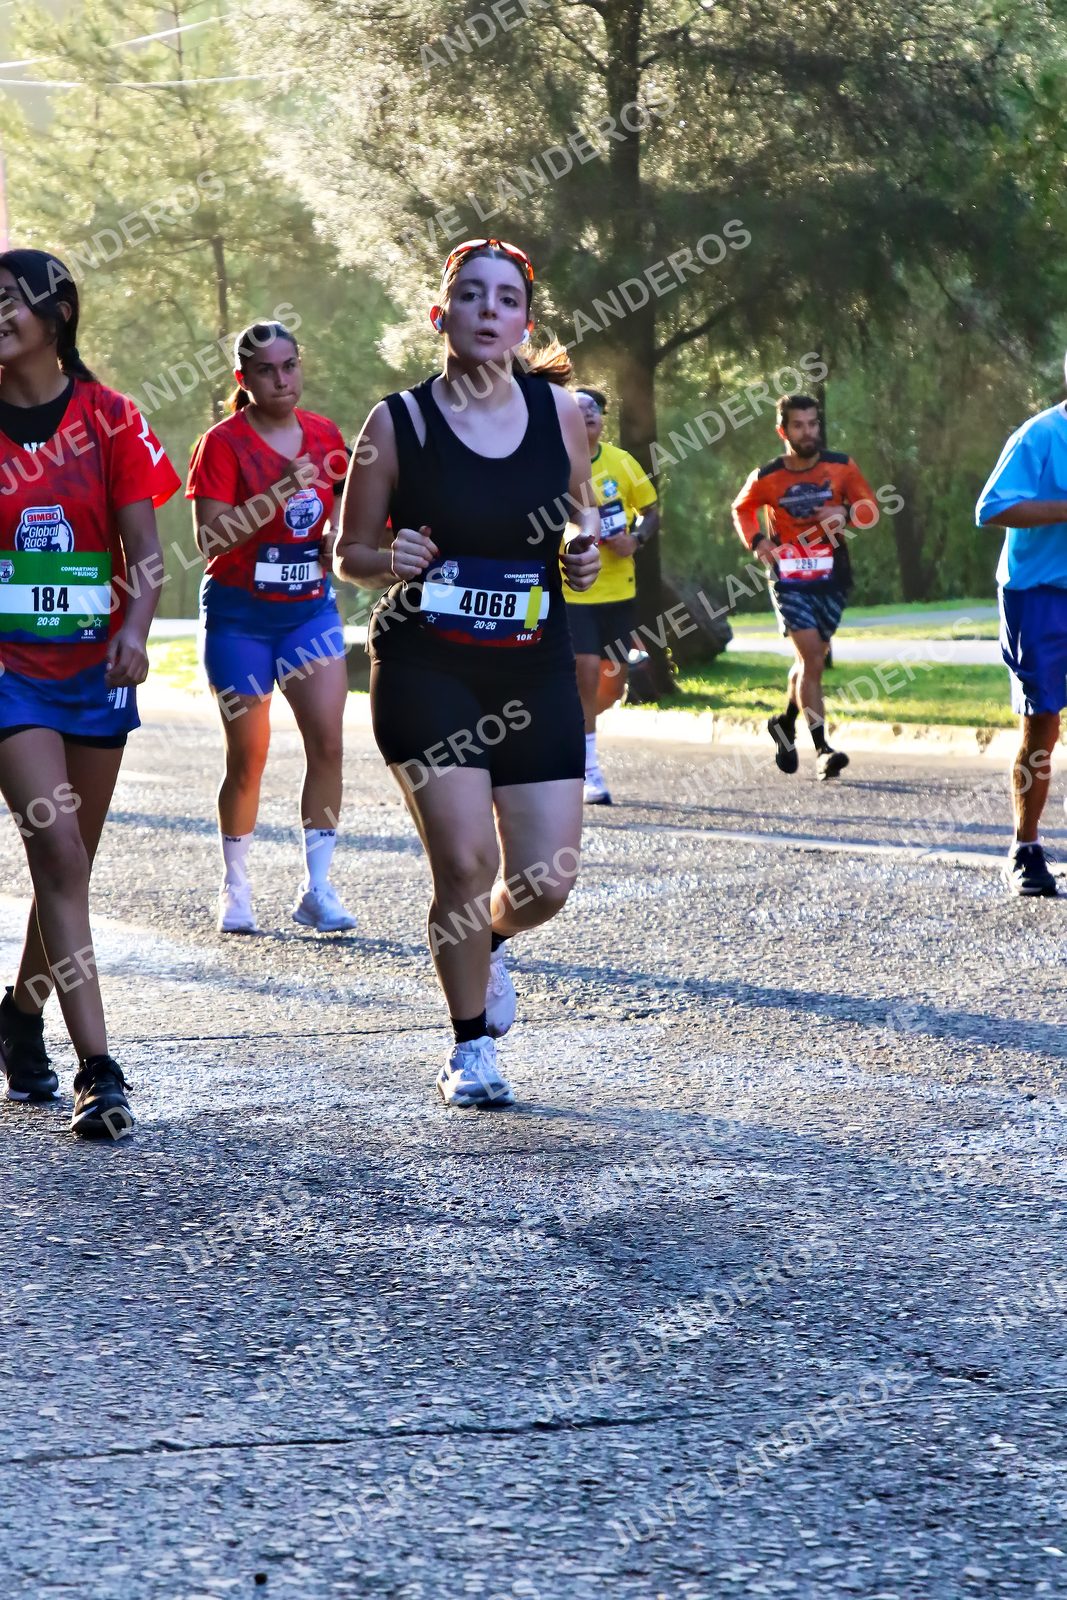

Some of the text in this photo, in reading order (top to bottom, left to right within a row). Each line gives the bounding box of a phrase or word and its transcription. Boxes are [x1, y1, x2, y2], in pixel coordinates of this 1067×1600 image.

[27, 512, 58, 523] BIMBO
[28, 524, 59, 538] Global
[23, 537, 48, 548] Race
[280, 563, 310, 581] 5401
[31, 586, 70, 613] 184
[459, 589, 517, 618] 4068
